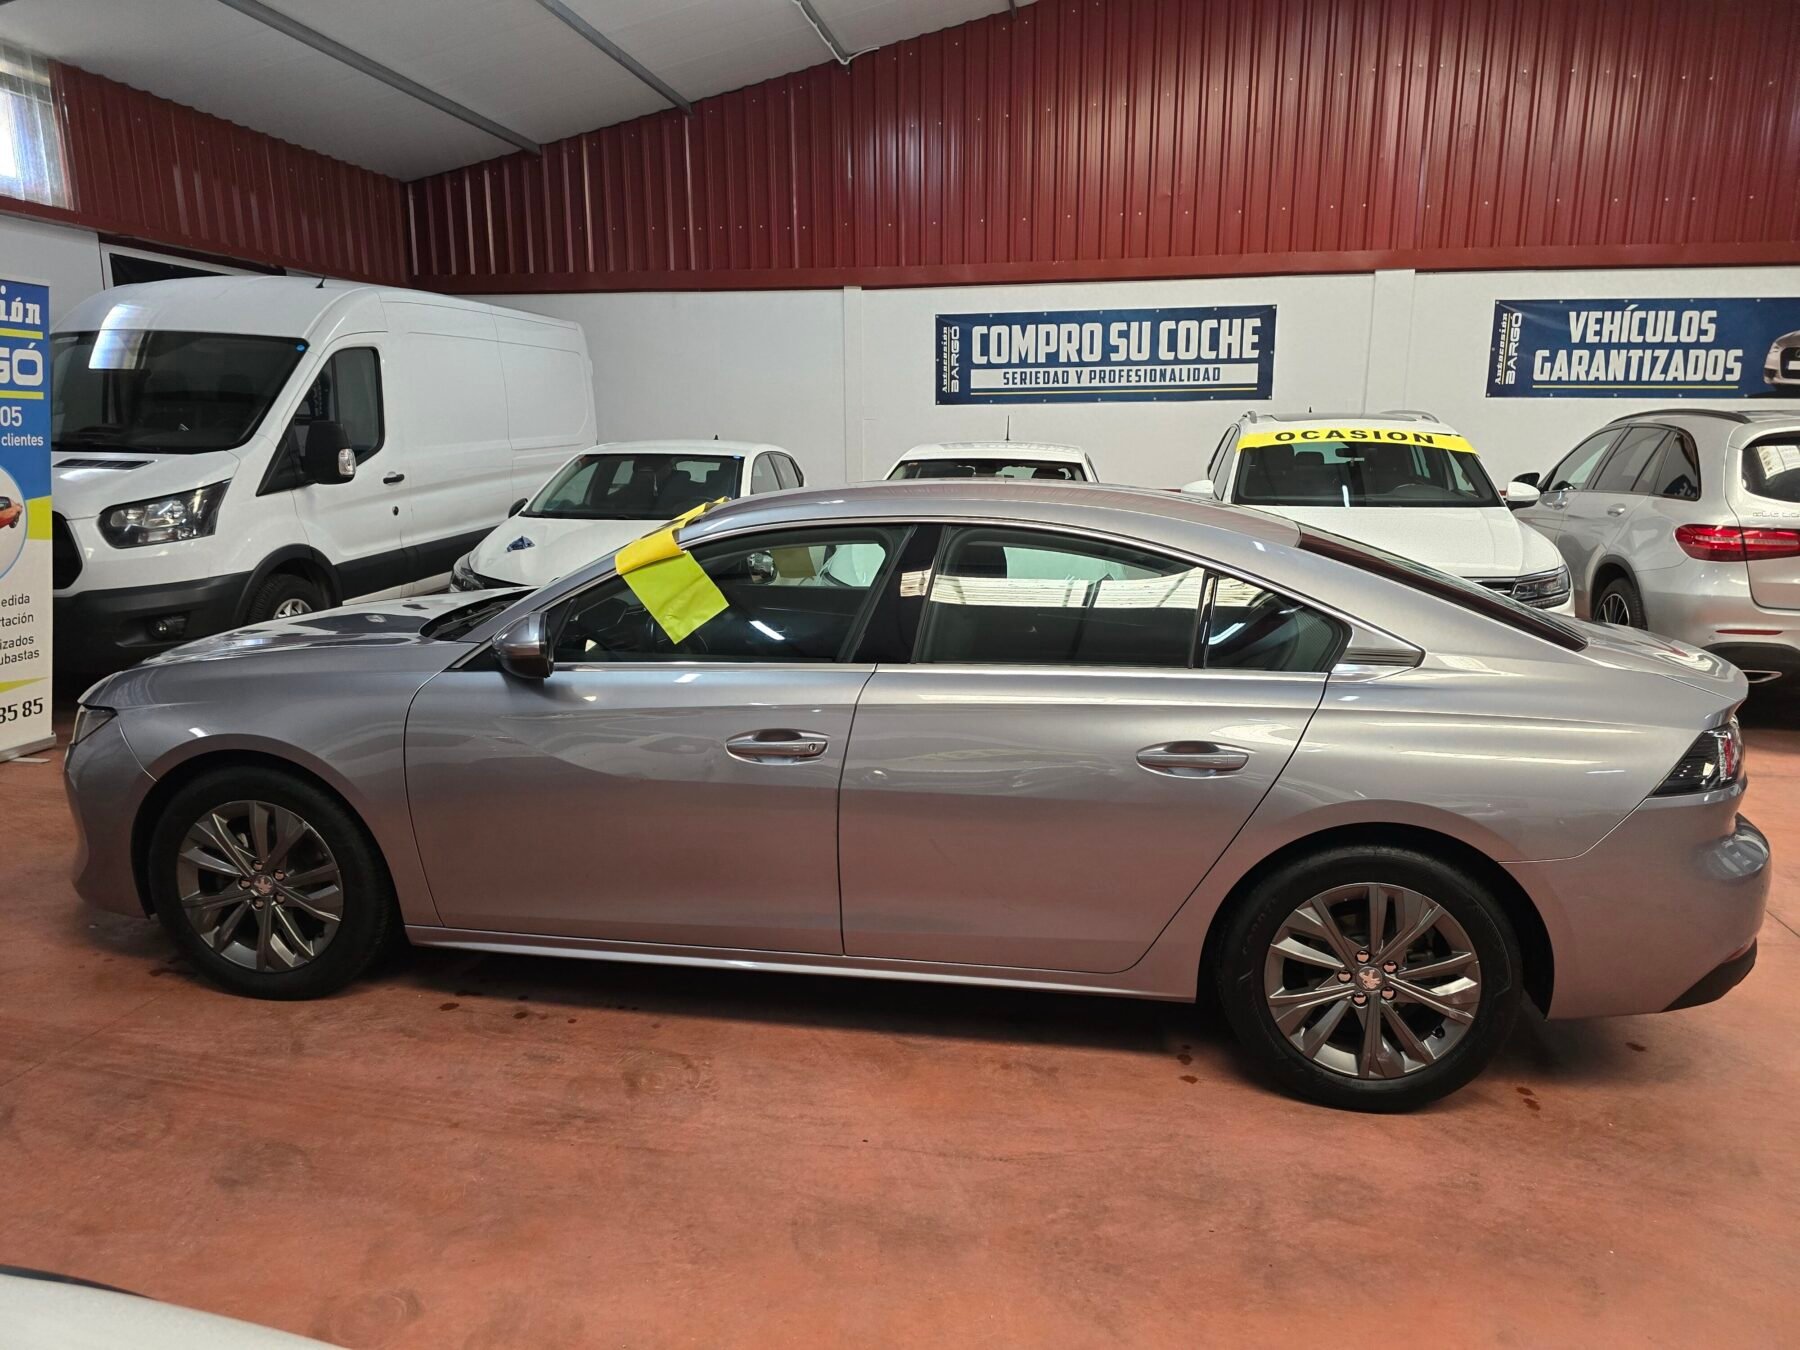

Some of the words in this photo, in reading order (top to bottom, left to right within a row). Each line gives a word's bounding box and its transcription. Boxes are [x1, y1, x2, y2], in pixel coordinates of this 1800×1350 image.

[1569, 304, 1718, 343] VEHÍCULOS
[972, 322, 1102, 364] COMPRO
[1109, 321, 1152, 361] SU
[1158, 317, 1262, 361] COCHE
[1505, 312, 1523, 385] BARGÓ
[950, 326, 960, 393] BARGÓ
[1532, 349, 1743, 382] GARANTIZADOS
[1003, 370, 1070, 386] SERIEDAD
[1075, 369, 1083, 385] Y
[1089, 367, 1222, 384] PROFESIONALIDAD
[0, 406, 22, 427] 05
[1, 433, 44, 447] clientes
[1275, 430, 1435, 445] OCASION
[1, 593, 30, 608] edida
[22, 697, 43, 717] 85
